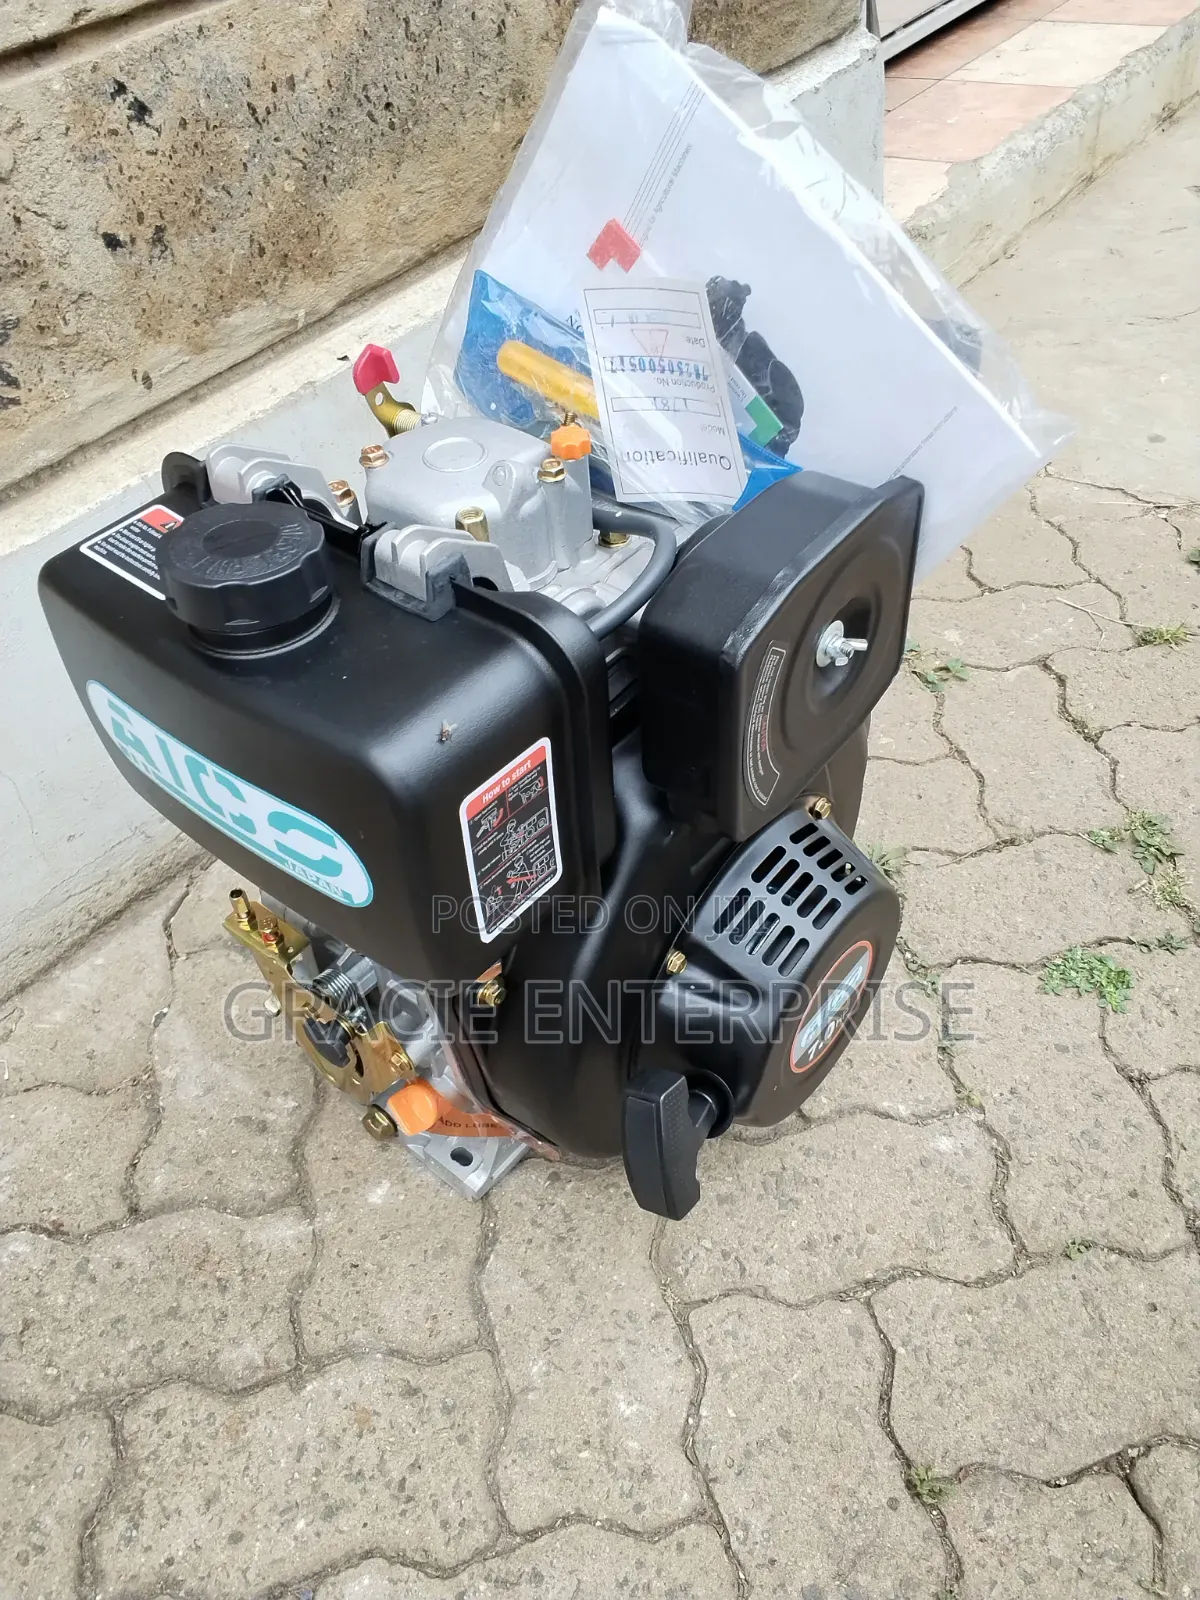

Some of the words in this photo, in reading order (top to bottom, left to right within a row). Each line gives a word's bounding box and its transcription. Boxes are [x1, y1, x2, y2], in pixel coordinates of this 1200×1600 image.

[686, 335, 706, 348] Date
[669, 378, 716, 394] Production
[622, 449, 732, 471] Qualification
[482, 784, 501, 805] How
[501, 777, 511, 788] to
[511, 759, 532, 780] start
[283, 858, 343, 899] JAPAN
[438, 1115, 462, 1128] ADD
